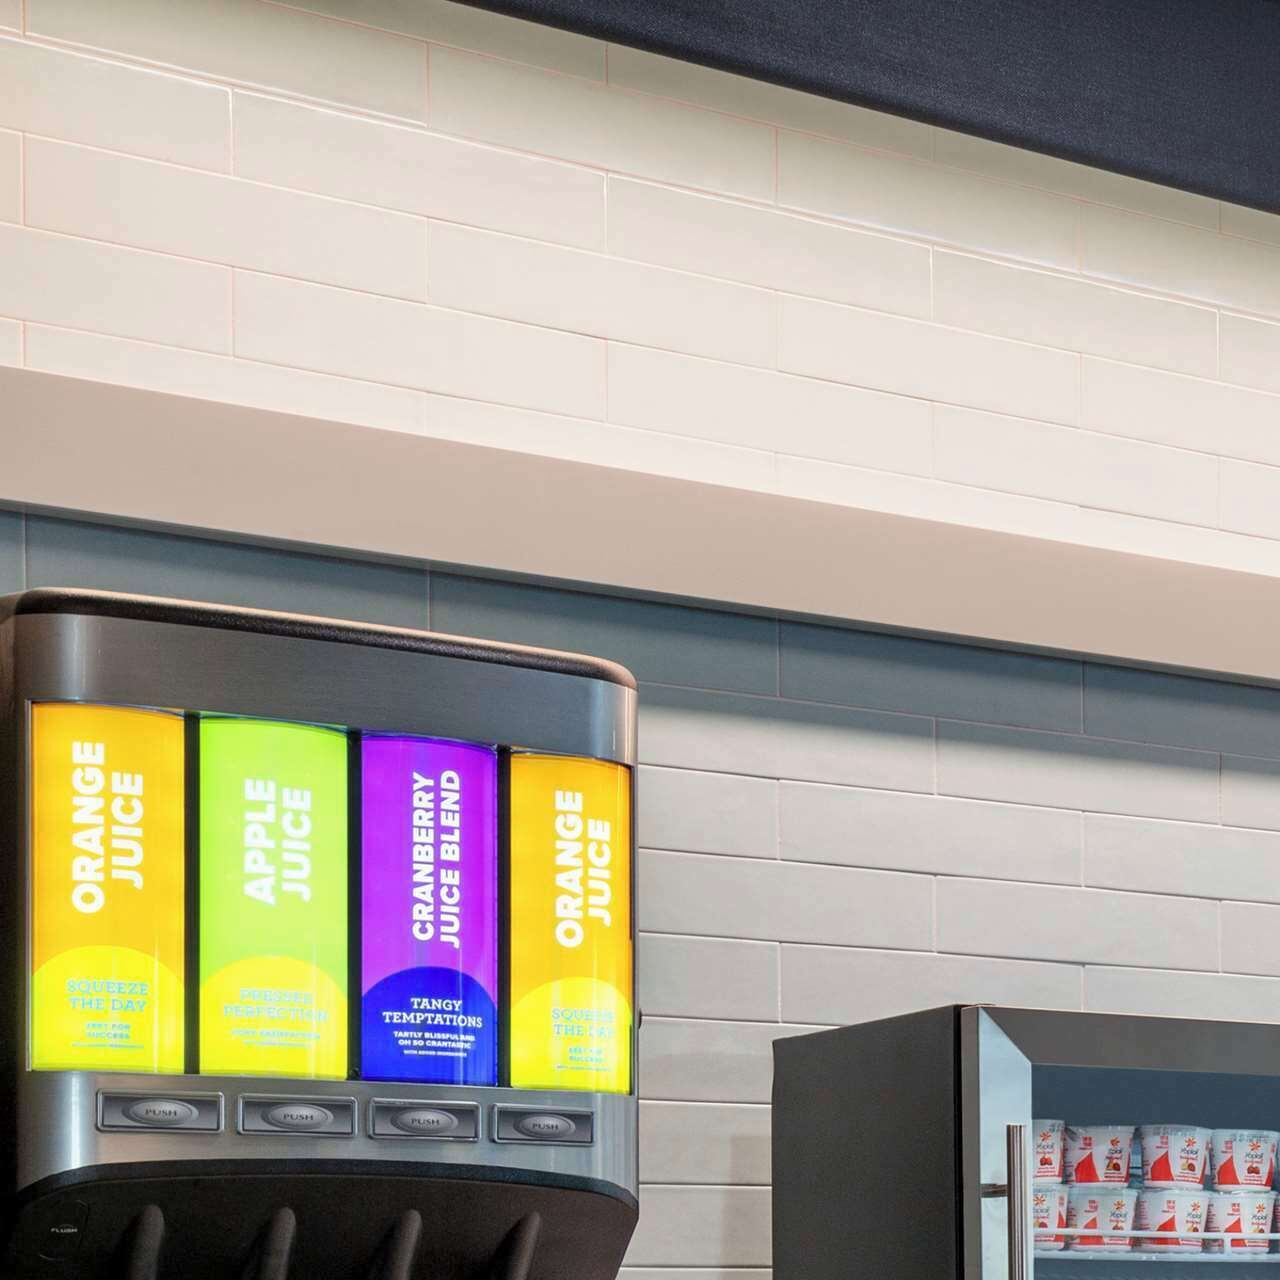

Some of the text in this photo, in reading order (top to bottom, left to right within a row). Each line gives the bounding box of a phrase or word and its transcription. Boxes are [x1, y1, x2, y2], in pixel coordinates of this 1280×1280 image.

[71, 741, 105, 914] ORANGE
[111, 772, 143, 889] JUICE
[243, 779, 277, 905] APPLE
[282, 787, 312, 900] JUICE
[411, 772, 435, 942] CRANBERRY
[439, 770, 460, 948] JUICE BLEND
[555, 790, 583, 948] ORANGE
[587, 819, 611, 926] JUICE
[66, 979, 148, 995] SQUEEZE
[69, 997, 148, 1012] THE DAY
[411, 997, 462, 1011] TANGY
[383, 1012, 482, 1028] TEMPTATIONS
[145, 1109, 178, 1118] PUSH
[283, 1113, 315, 1122] PUSH
[410, 1117, 441, 1126] PUSH
[531, 1122, 560, 1130] PUSH
